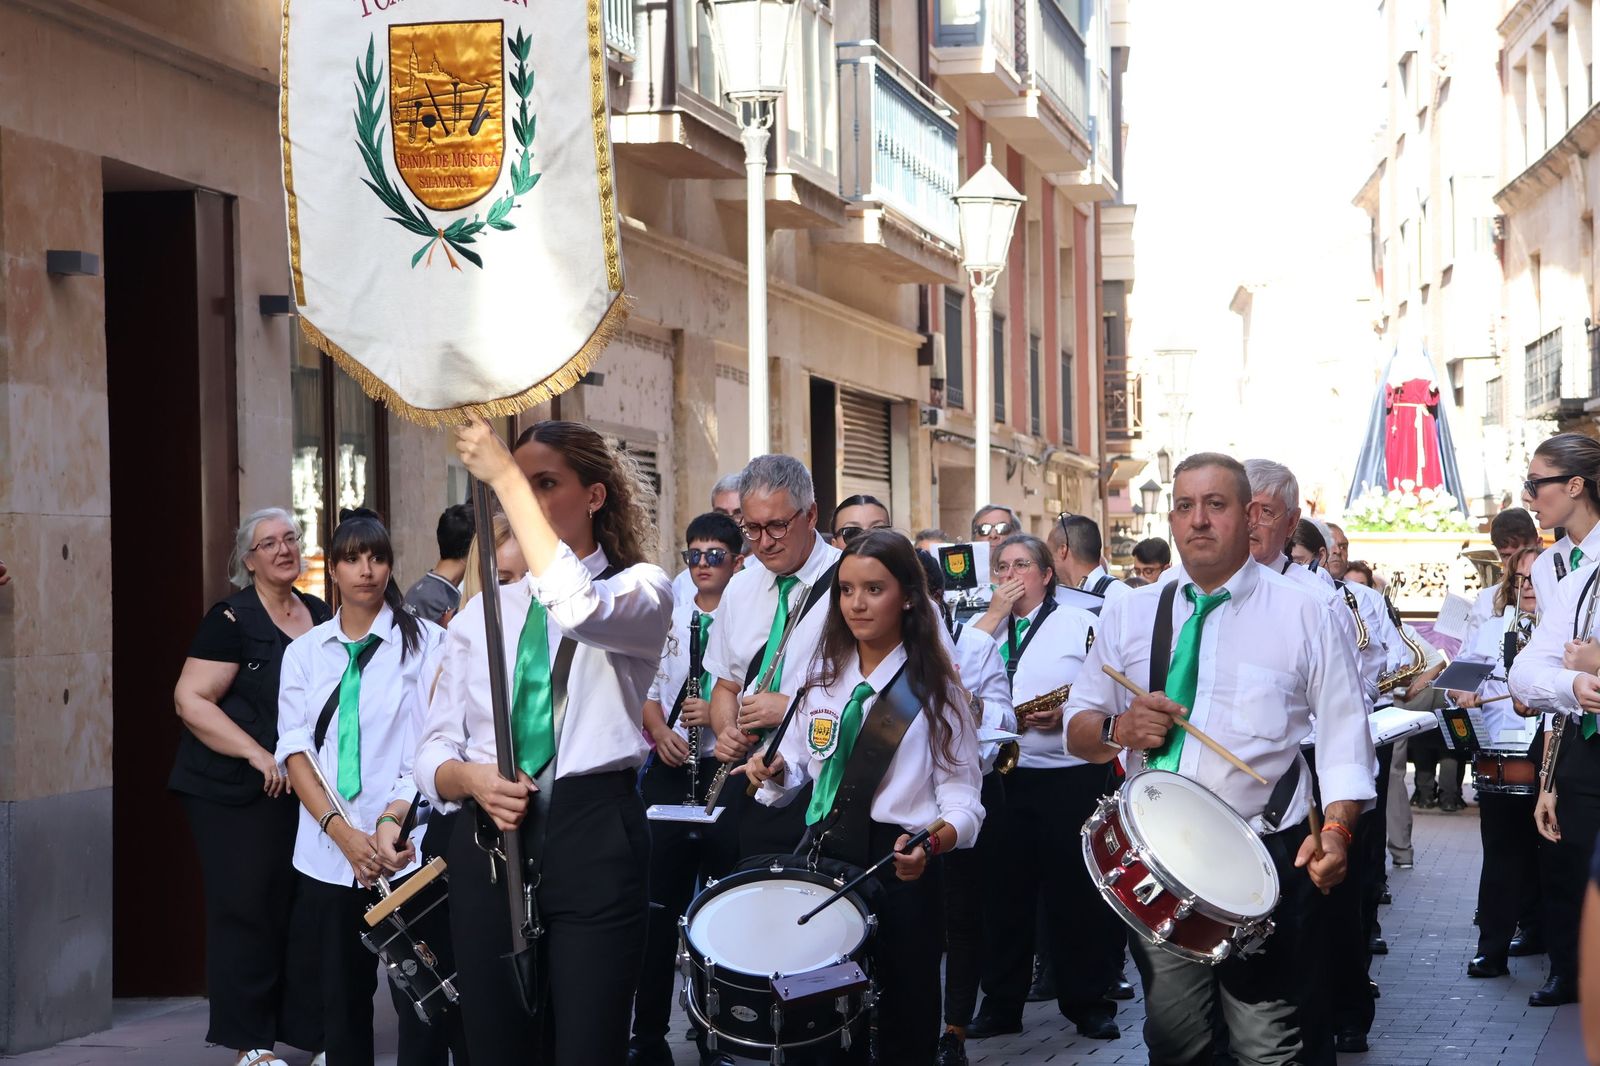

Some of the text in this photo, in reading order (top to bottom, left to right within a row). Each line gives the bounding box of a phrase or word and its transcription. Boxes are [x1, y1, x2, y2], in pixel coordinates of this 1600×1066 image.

[400, 153, 432, 168] BANDA
[435, 154, 448, 168] DE
[418, 175, 474, 188] SALAMANCA
